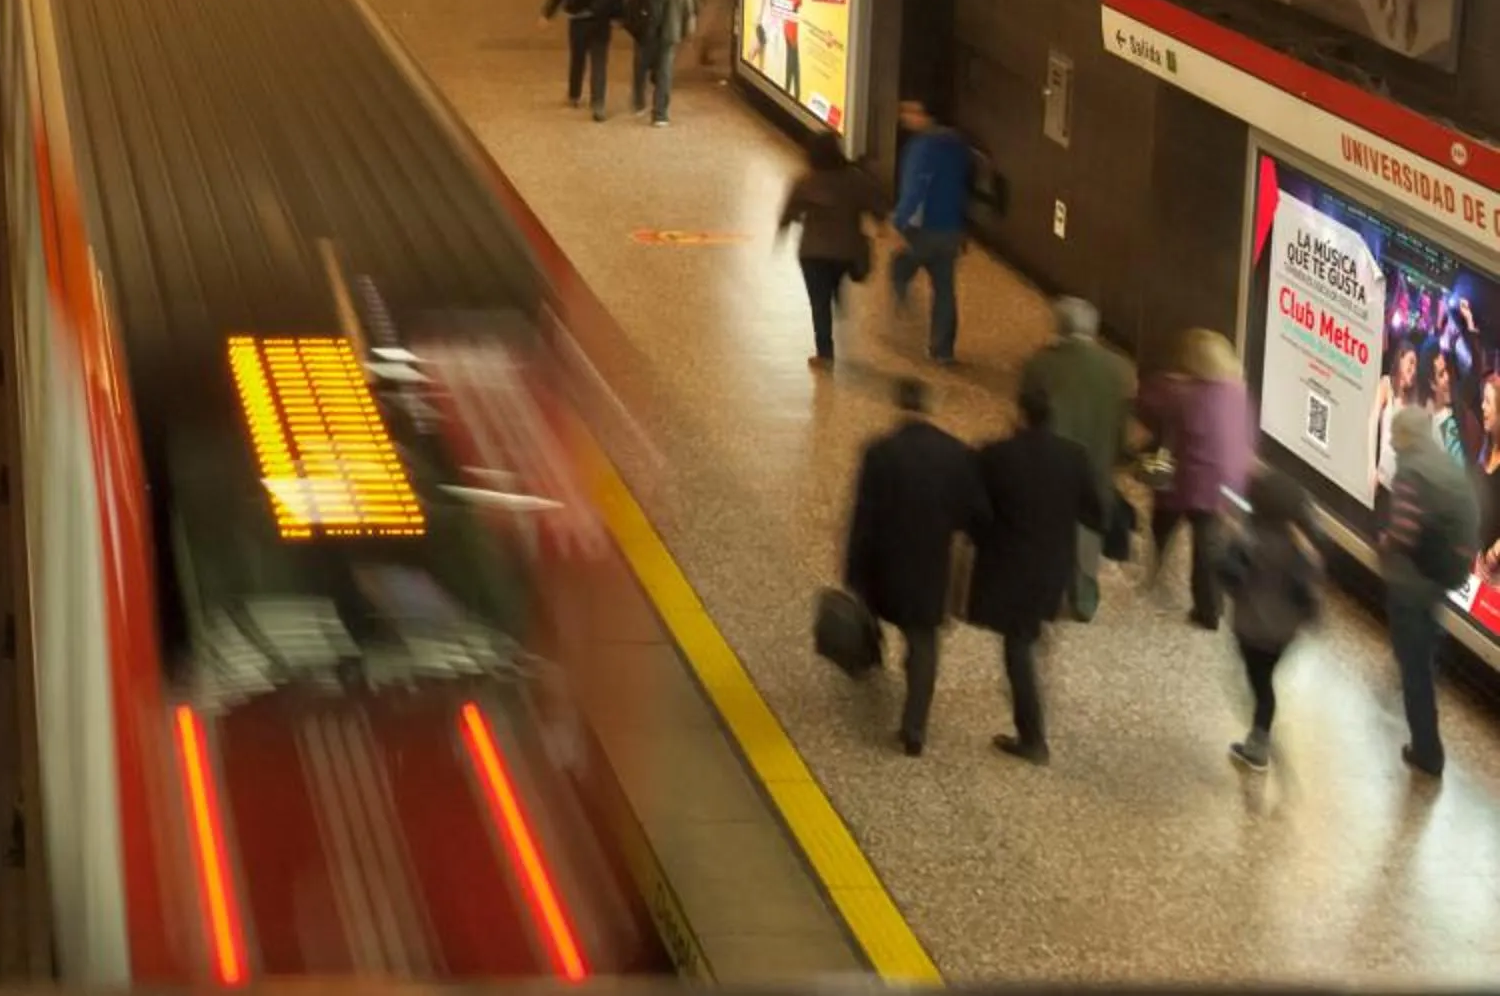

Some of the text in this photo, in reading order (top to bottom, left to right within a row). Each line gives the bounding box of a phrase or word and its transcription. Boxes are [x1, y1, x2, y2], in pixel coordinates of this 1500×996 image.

[1129, 35, 1162, 66] Salida
[1340, 132, 1455, 213] UNIVERSIDAD
[1462, 192, 1487, 229] DE
[1286, 242, 1309, 270] QUE
[1312, 255, 1325, 280] TE
[1327, 267, 1367, 304] GUSTA
[1297, 228, 1311, 251] LA
[1314, 238, 1357, 279] MÚSICA
[1280, 286, 1315, 331] Club
[1319, 308, 1369, 365] Metro
